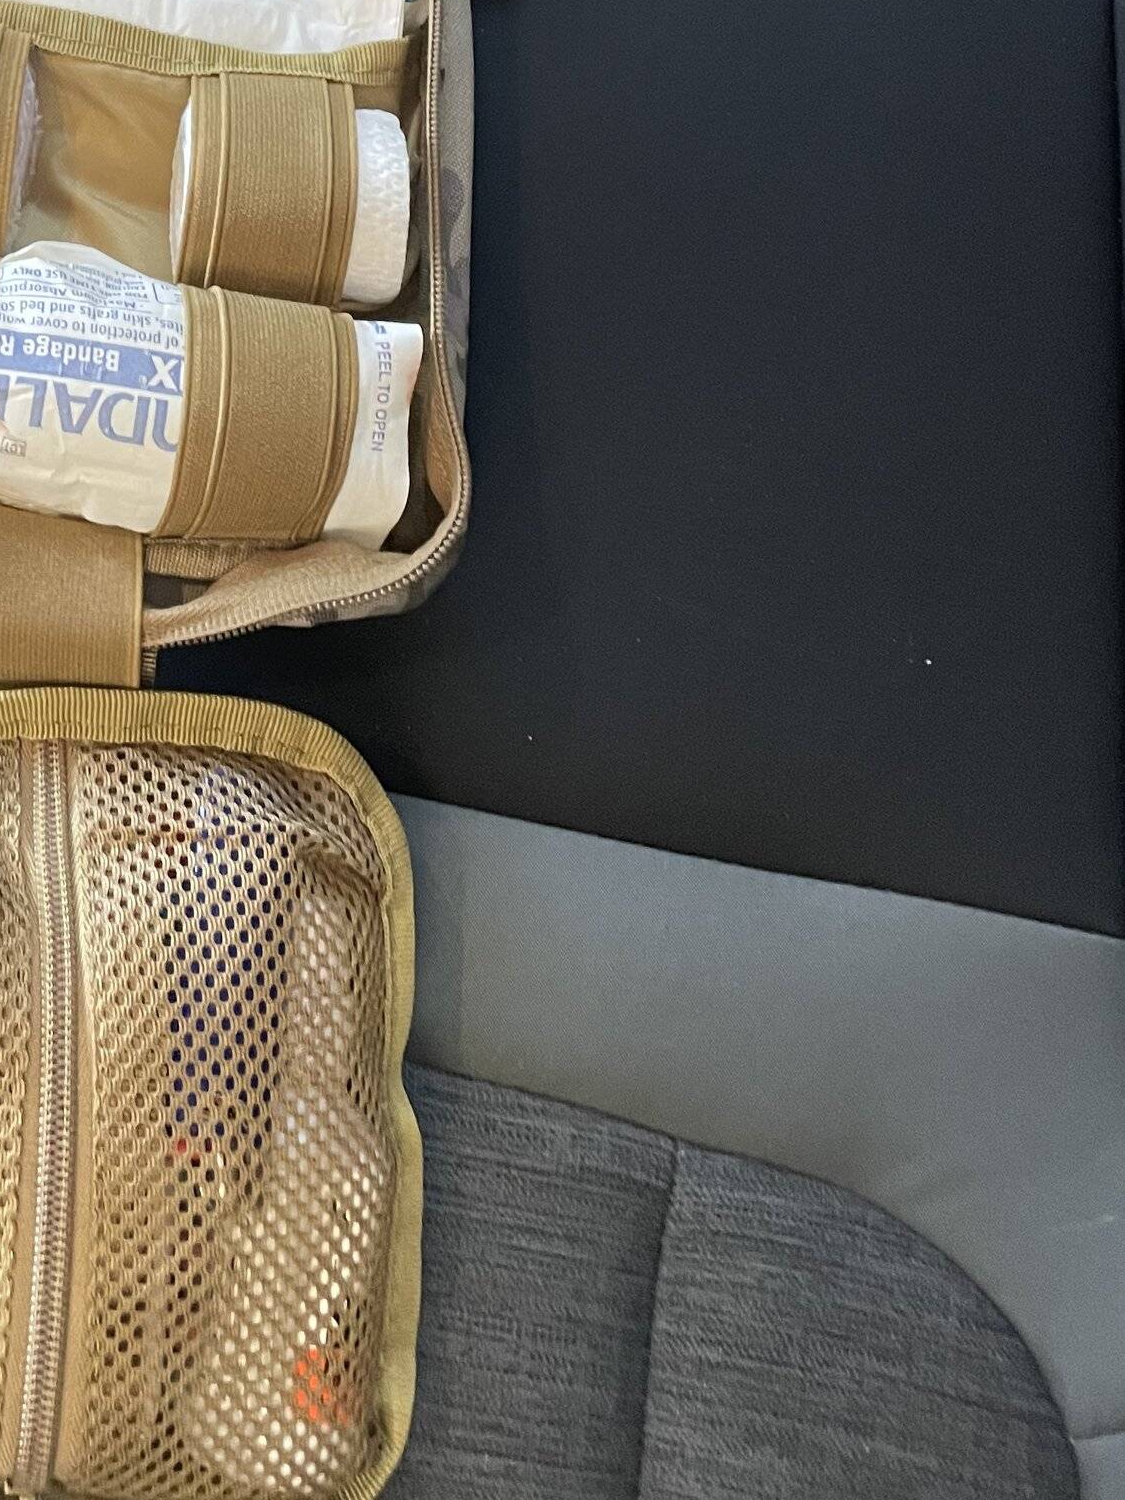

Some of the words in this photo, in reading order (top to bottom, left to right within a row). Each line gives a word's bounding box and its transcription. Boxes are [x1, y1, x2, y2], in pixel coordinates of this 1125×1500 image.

[11, 266, 42, 279] ONLY
[43, 269, 67, 281] USE
[20, 298, 46, 316] bed
[50, 301, 76, 318] and
[79, 303, 120, 323] grafts
[30, 315, 68, 332] cover
[72, 320, 86, 336] to
[123, 312, 152, 330] skin
[91, 322, 161, 346] protection
[165, 336, 179, 350] of
[22, 334, 121, 372] Bandage
[375, 340, 392, 379] PEEL
[376, 383, 391, 403] TO
[370, 408, 389, 452] OPEN
